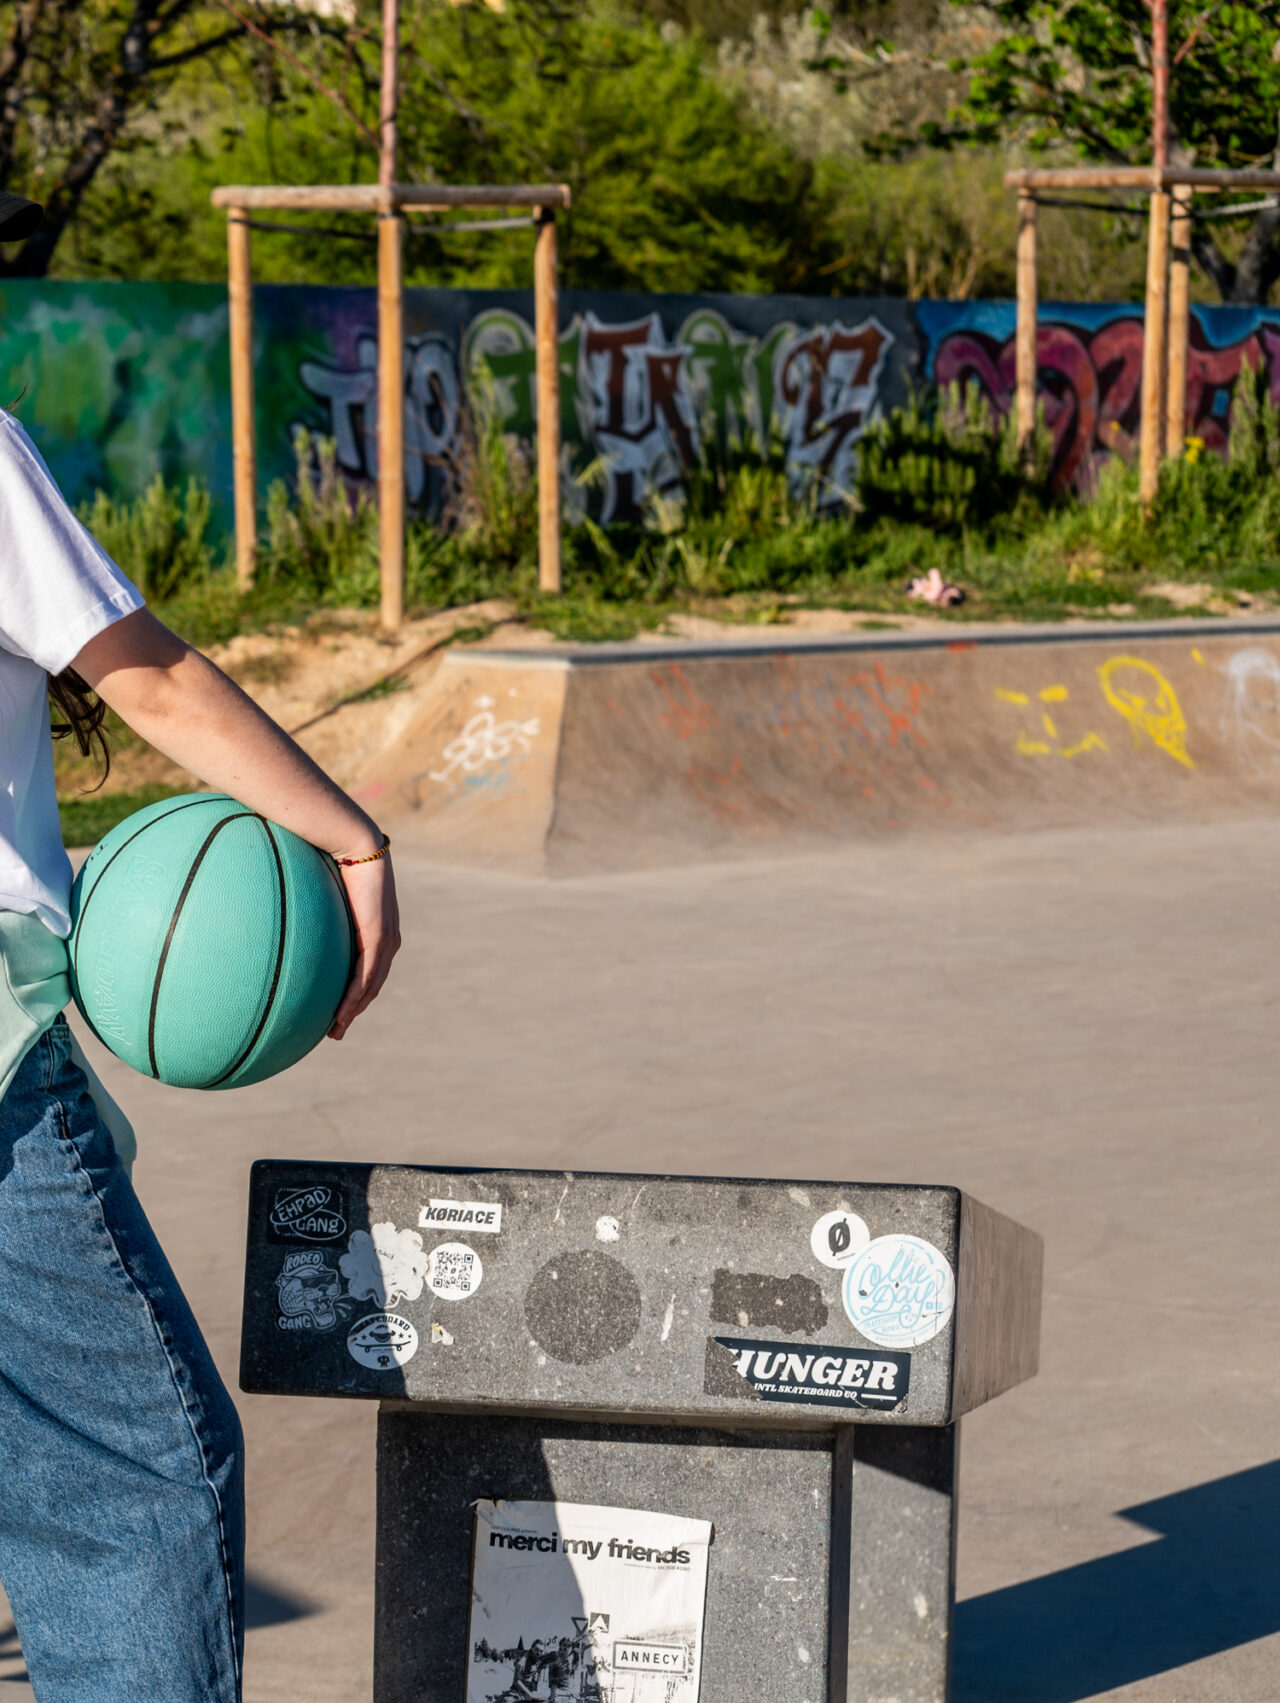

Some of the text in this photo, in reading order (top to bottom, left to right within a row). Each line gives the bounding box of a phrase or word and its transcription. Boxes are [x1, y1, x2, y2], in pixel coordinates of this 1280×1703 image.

[285, 1251, 321, 1271] RODEO
[278, 1315, 312, 1330] GANG
[753, 1383, 776, 1393] INTL
[778, 1384, 843, 1398] SKATEBOARD
[490, 1531, 691, 1565] merci my friends
[620, 1650, 679, 1665] ANNECY
